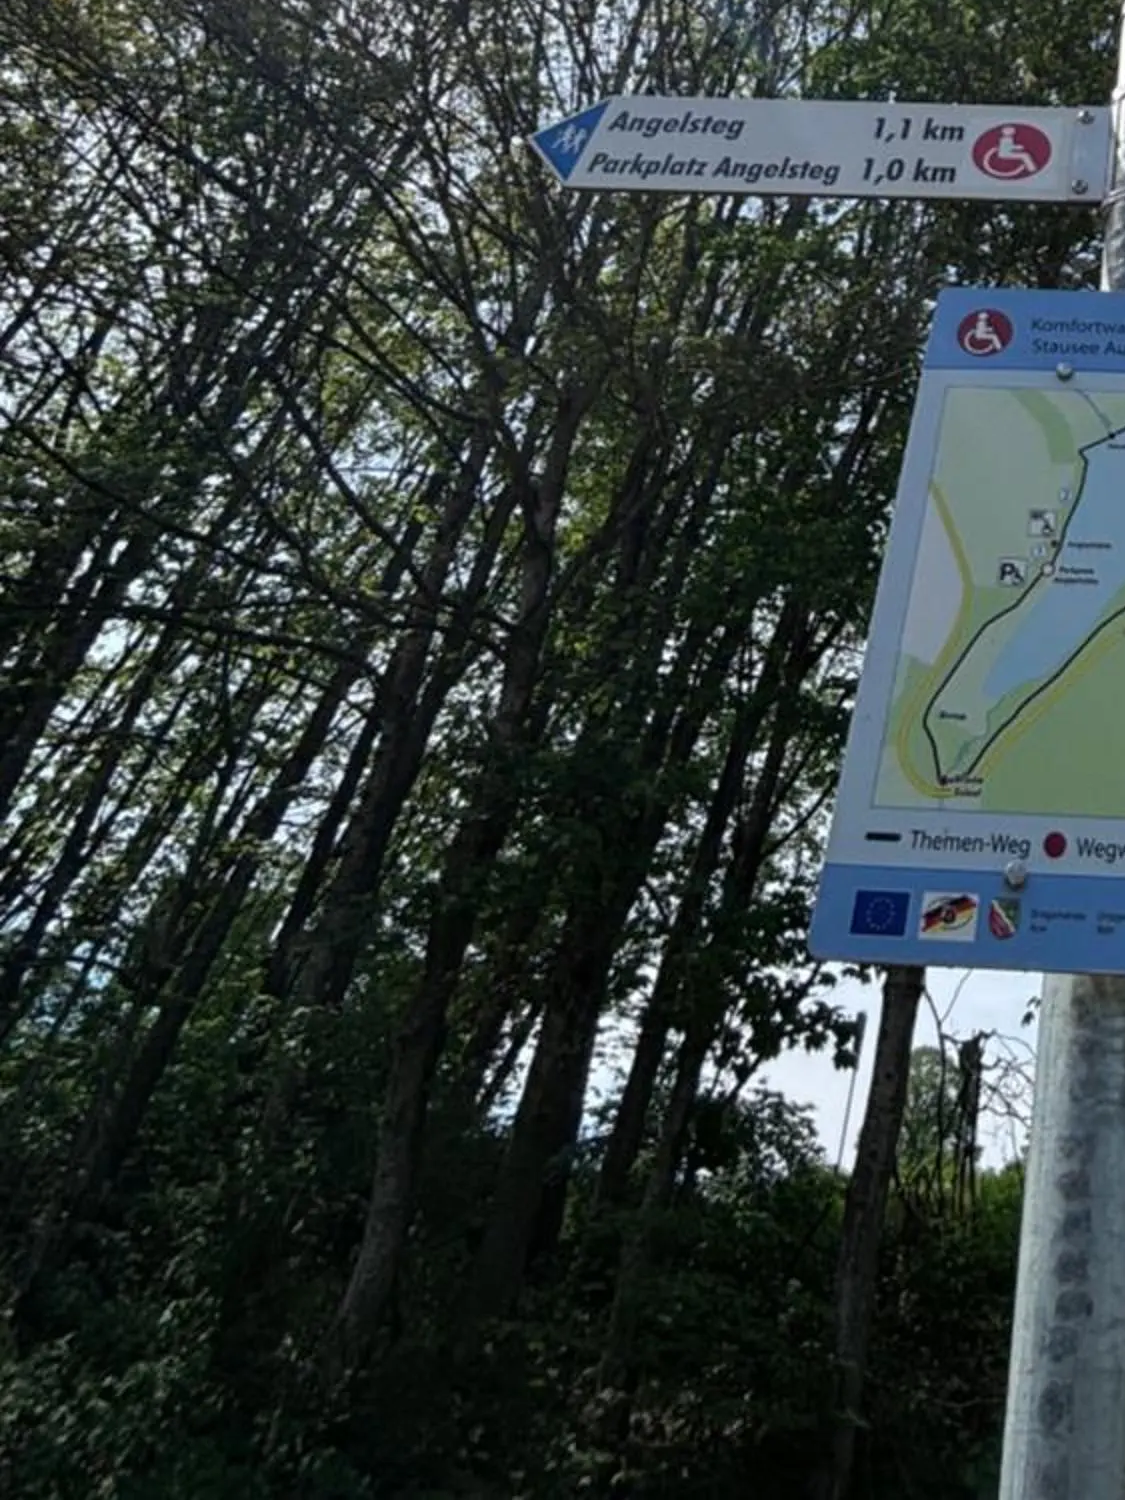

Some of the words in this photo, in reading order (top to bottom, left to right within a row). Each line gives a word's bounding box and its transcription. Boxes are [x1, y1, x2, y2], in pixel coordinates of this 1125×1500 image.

[608, 111, 745, 141] Angelsteg
[874, 117, 912, 143] 1,1
[924, 117, 965, 142] km
[587, 153, 706, 182] Parkplatz
[712, 156, 839, 185] Angelsteg
[861, 158, 903, 185] 1,0
[914, 158, 956, 183] km
[1032, 338, 1100, 356] Stausee
[911, 829, 1031, 860] Themen-Weg
